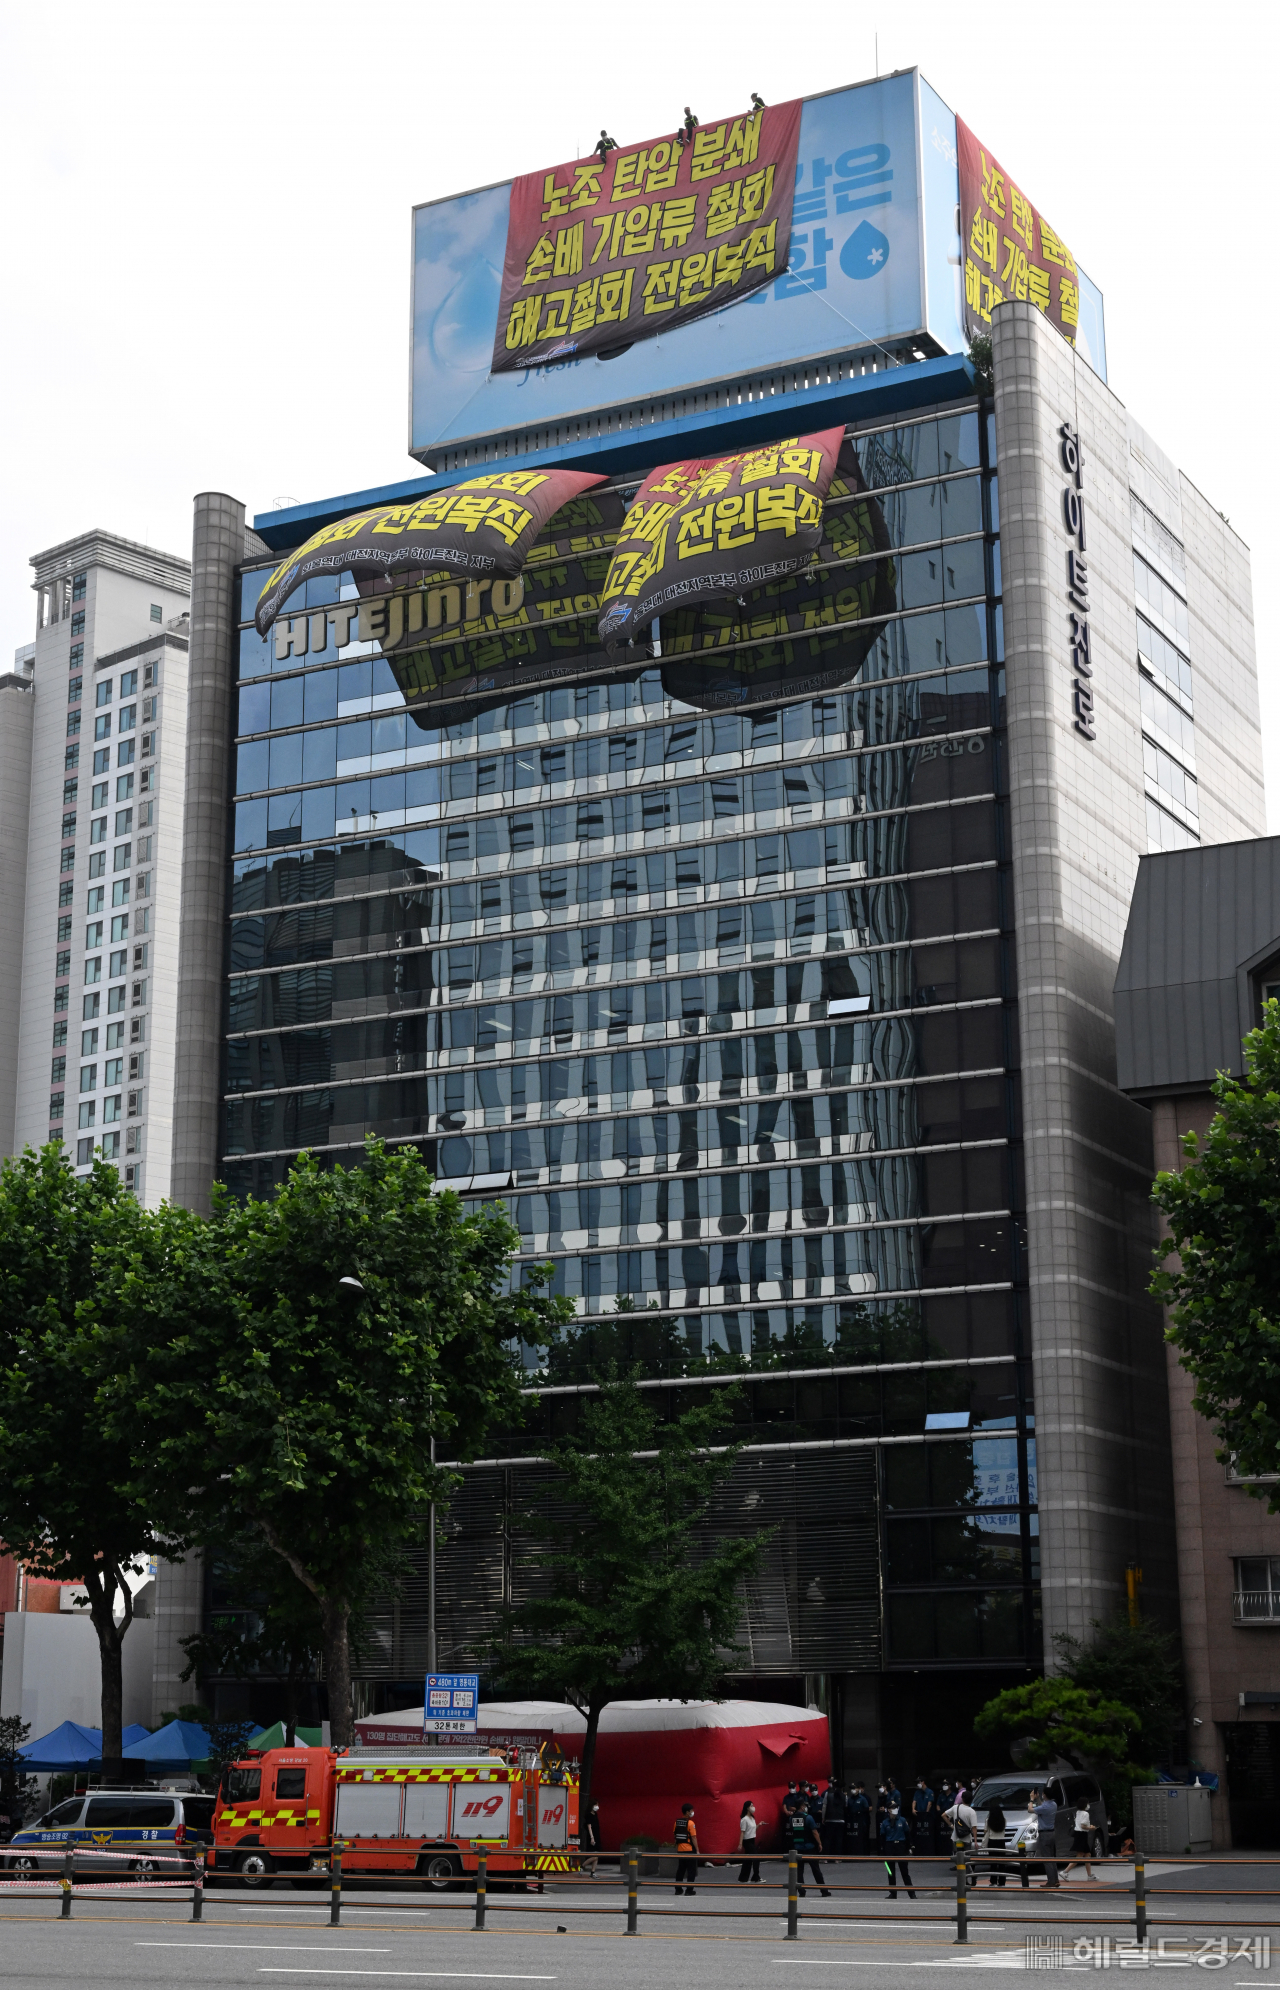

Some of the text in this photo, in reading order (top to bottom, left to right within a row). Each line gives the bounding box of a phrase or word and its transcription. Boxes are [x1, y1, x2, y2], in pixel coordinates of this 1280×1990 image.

[541, 110, 763, 222] 노조 탄압 분쇄
[522, 164, 776, 287] 손배 가압류 철회
[979, 148, 1006, 219] 노조
[1009, 184, 1034, 252] 탄압
[505, 218, 778, 351] 해고철회 전원복직
[970, 206, 998, 273] 손배
[1000, 236, 1051, 313] 가압류
[371, 495, 534, 547] 전원복직
[411, 546, 468, 566] 하이트진로
[469, 555, 495, 570] 지부
[665, 572, 737, 602] 대전지역본부
[739, 559, 797, 584] 하이트진로
[1060, 422, 1096, 741] 하이트진로
[366, 1731, 386, 1740] 130명
[461, 1795, 504, 1817] 119
[541, 1804, 564, 1825] 119
[142, 1830, 159, 1840] 경찰
